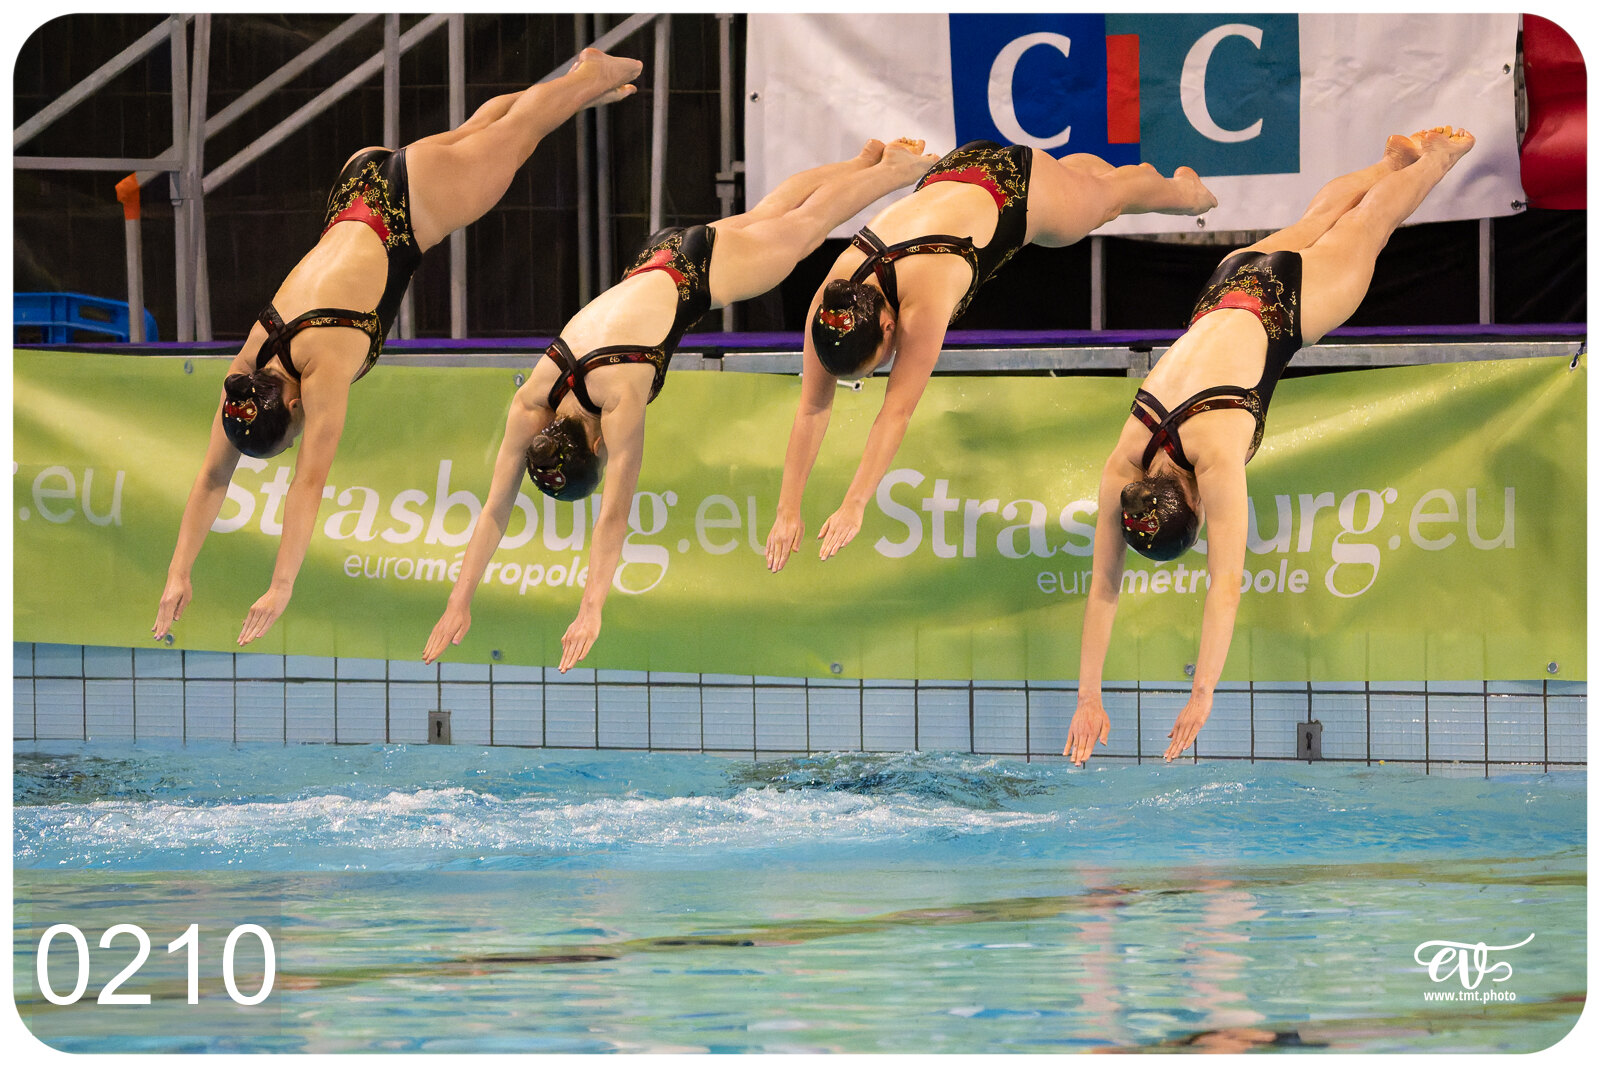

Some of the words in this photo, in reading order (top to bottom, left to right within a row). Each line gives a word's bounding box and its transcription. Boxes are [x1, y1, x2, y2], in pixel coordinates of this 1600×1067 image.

[987, 24, 1264, 150] CIC
[13, 461, 125, 526] .eu
[874, 468, 1515, 598] Strasurg.eu
[344, 551, 589, 595] euroméropole
[1037, 559, 1310, 594] eurmétrole
